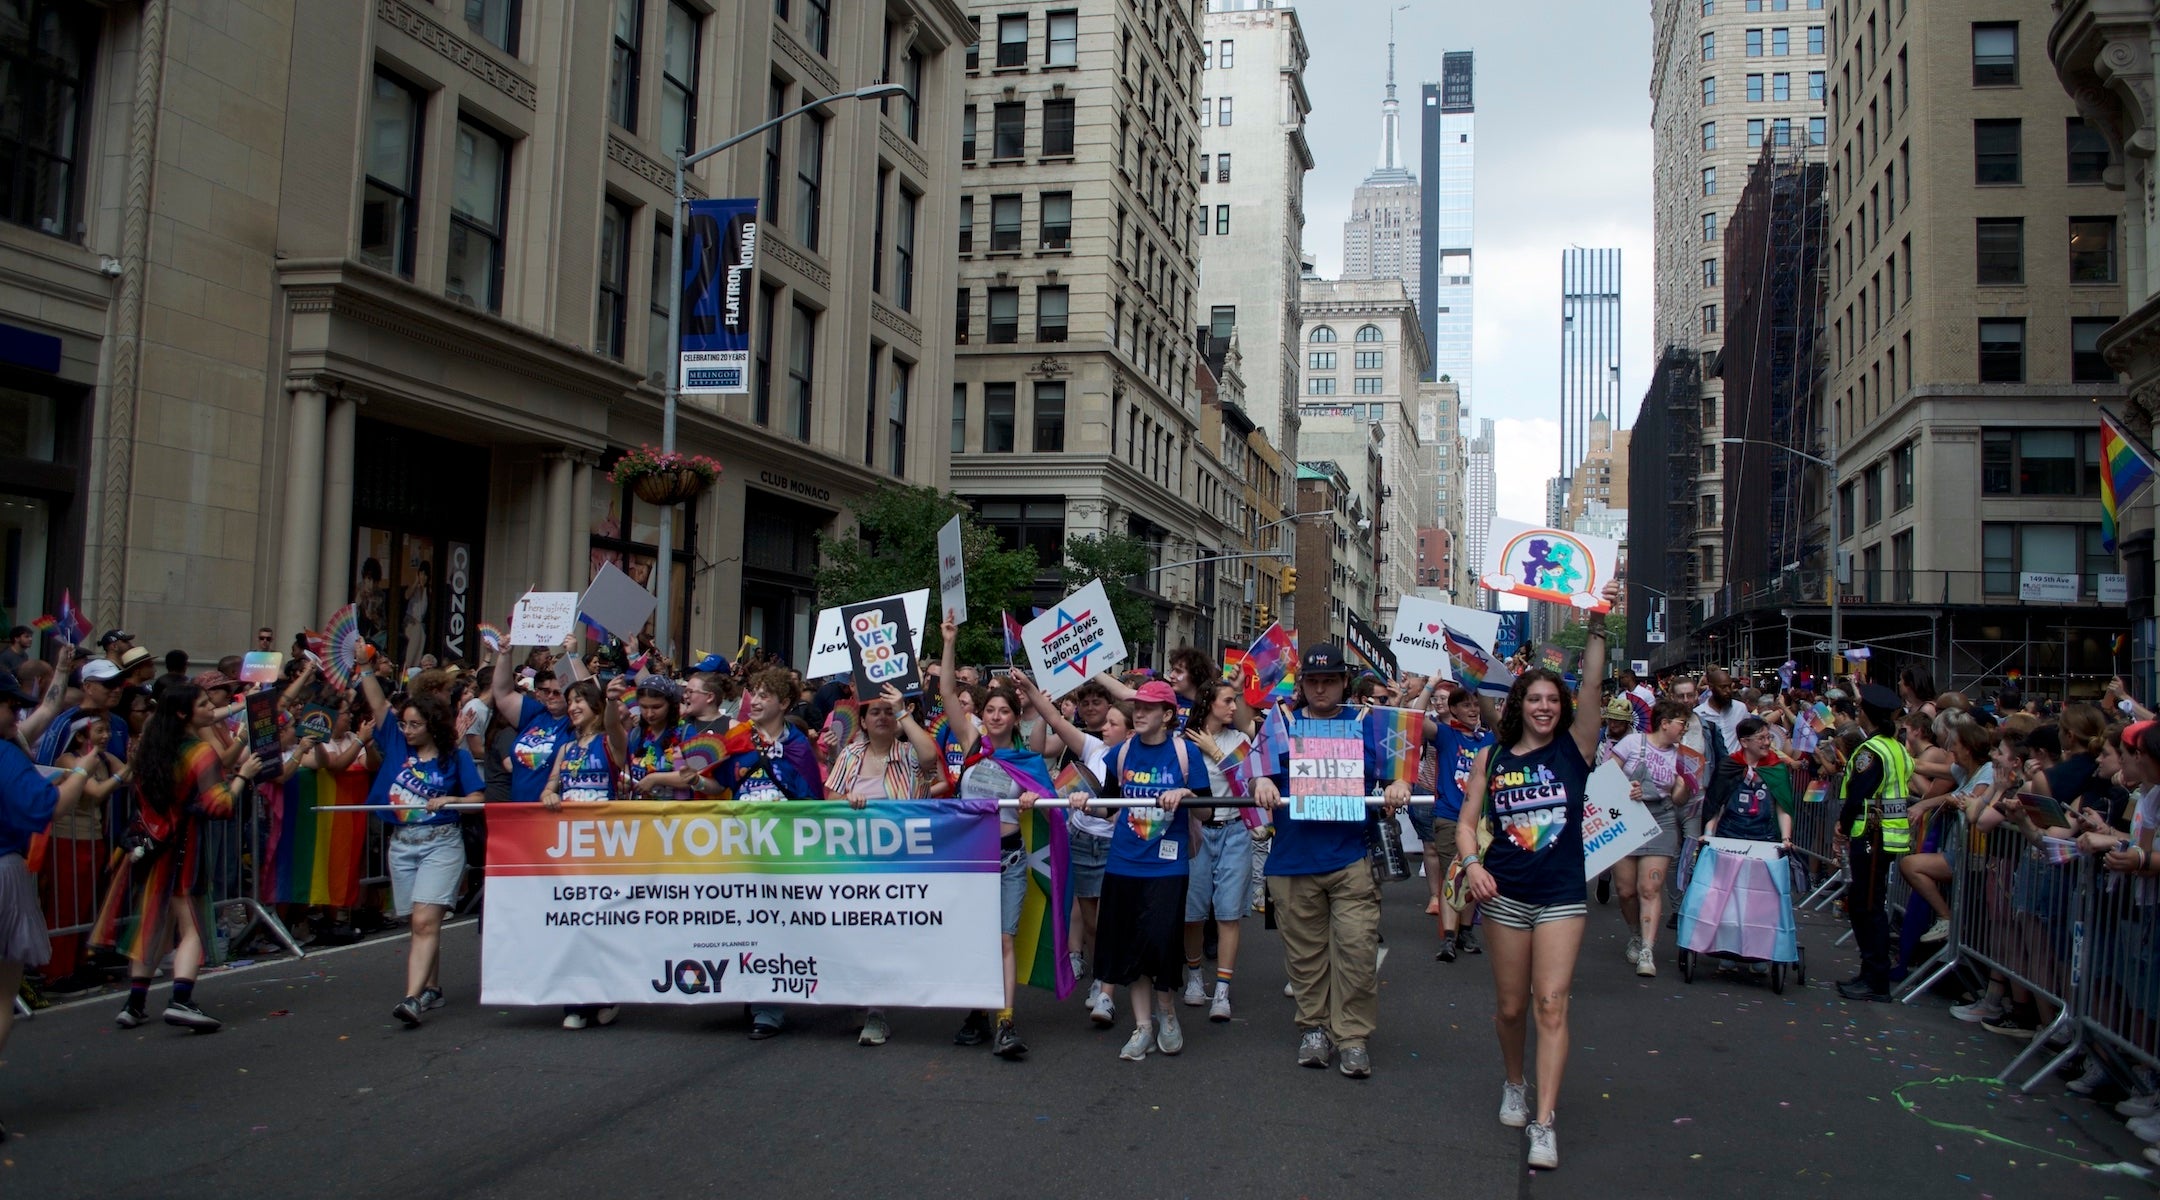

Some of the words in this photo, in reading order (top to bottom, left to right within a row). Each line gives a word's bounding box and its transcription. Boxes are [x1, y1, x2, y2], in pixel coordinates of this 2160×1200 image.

[740, 222, 756, 270] NOMAD
[726, 265, 742, 326] FLATIRON
[684, 354, 720, 362] CELEBRATING
[760, 471, 788, 488] CLUB
[790, 480, 830, 502] MONACO
[856, 614, 878, 632] OY
[1418, 622, 1422, 632] I
[858, 627, 893, 648] VEY
[1042, 633, 1070, 655] Trans
[1072, 616, 1098, 638] Jews
[1396, 633, 1438, 650] Jewish
[818, 642, 850, 654] Jew
[864, 646, 890, 663] SO
[1044, 642, 1080, 670] belong
[1080, 628, 1104, 648] here
[1350, 628, 1393, 678] NACHAS
[870, 658, 904, 678] GAY
[1497, 784, 1562, 810] queer
[1500, 806, 1567, 831] PRIDE
[1609, 808, 1622, 819] &
[1884, 803, 1908, 814] NYPD
[546, 820, 640, 858] JEW
[654, 818, 781, 857] YORK
[794, 818, 934, 856] PRIDE
[554, 885, 620, 902] LGBTQ+
[626, 885, 689, 900] JEWISH
[694, 884, 757, 900] YOUTH
[762, 884, 776, 898] IN
[782, 885, 823, 900] NEW
[829, 884, 880, 900] YORK
[886, 884, 928, 899] CITY
[546, 910, 640, 926] MARCHING
[646, 911, 678, 925] FOR
[683, 910, 741, 926] PRIDE,
[746, 910, 786, 926] JOY,
[790, 911, 826, 926] AND
[832, 911, 942, 926] LIBERATION
[740, 952, 818, 976] Keshet
[772, 978, 818, 998] קשת
